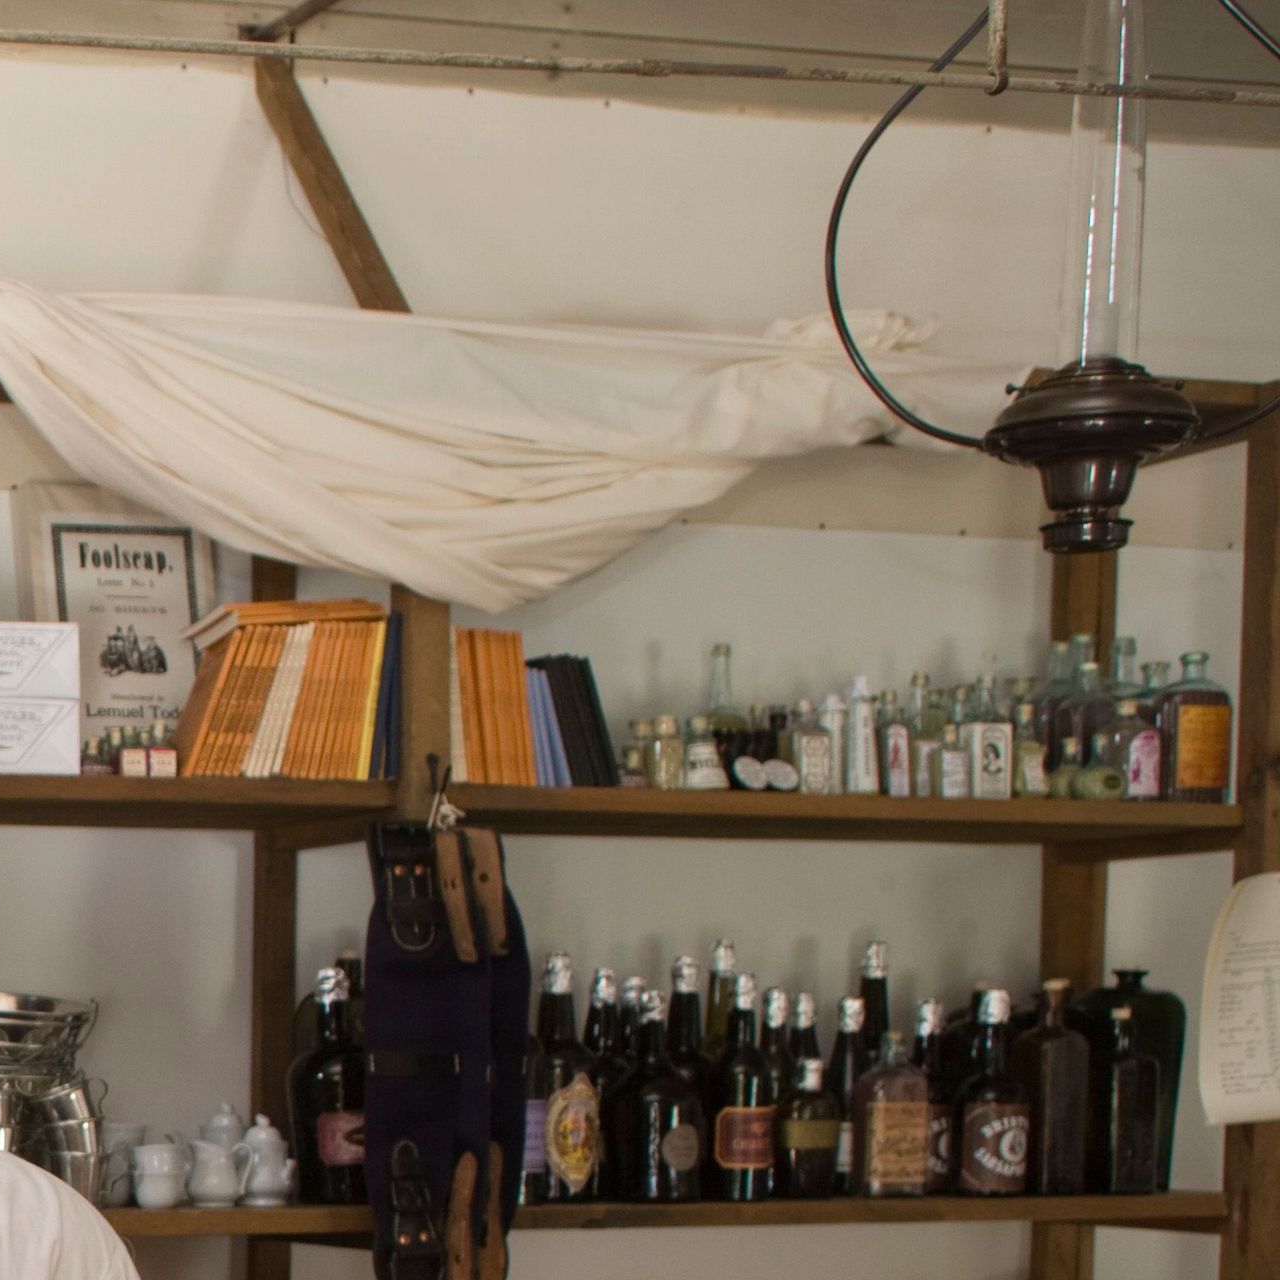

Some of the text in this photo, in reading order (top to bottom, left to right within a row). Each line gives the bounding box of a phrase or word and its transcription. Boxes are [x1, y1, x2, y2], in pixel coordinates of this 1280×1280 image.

[79, 542, 173, 574] Foolscap.
[86, 704, 183, 720] Lemuel Tod
